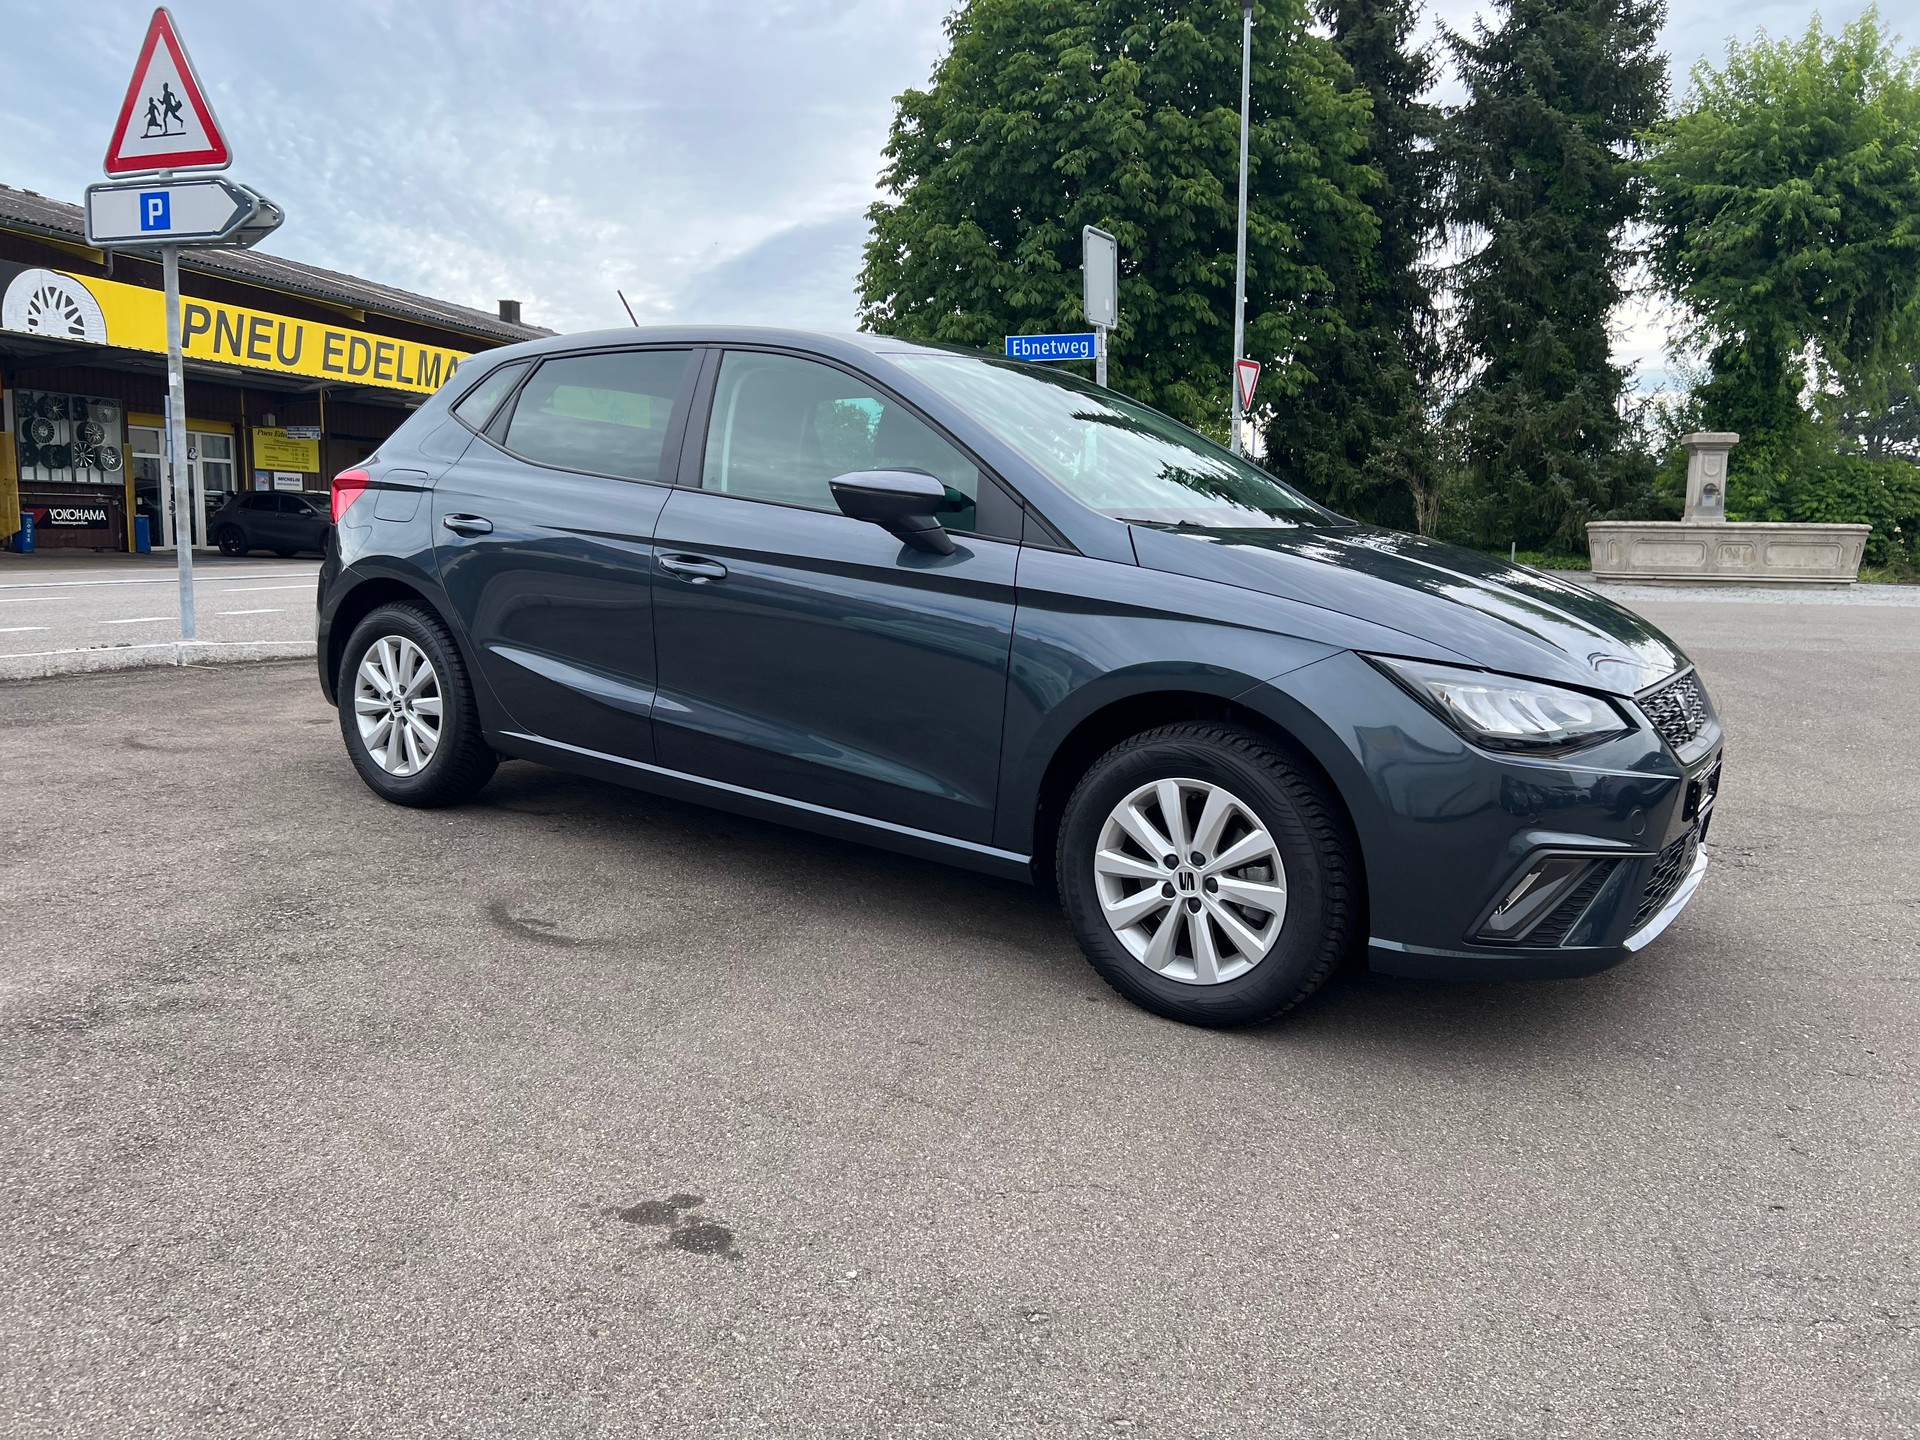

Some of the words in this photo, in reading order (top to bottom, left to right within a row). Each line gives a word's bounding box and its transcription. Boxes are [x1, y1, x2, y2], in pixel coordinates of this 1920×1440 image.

[148, 198, 163, 226] P
[181, 303, 304, 367] PNEU
[1012, 338, 1089, 358] Ebnetweg
[48, 508, 107, 521] YOKOHAMA
